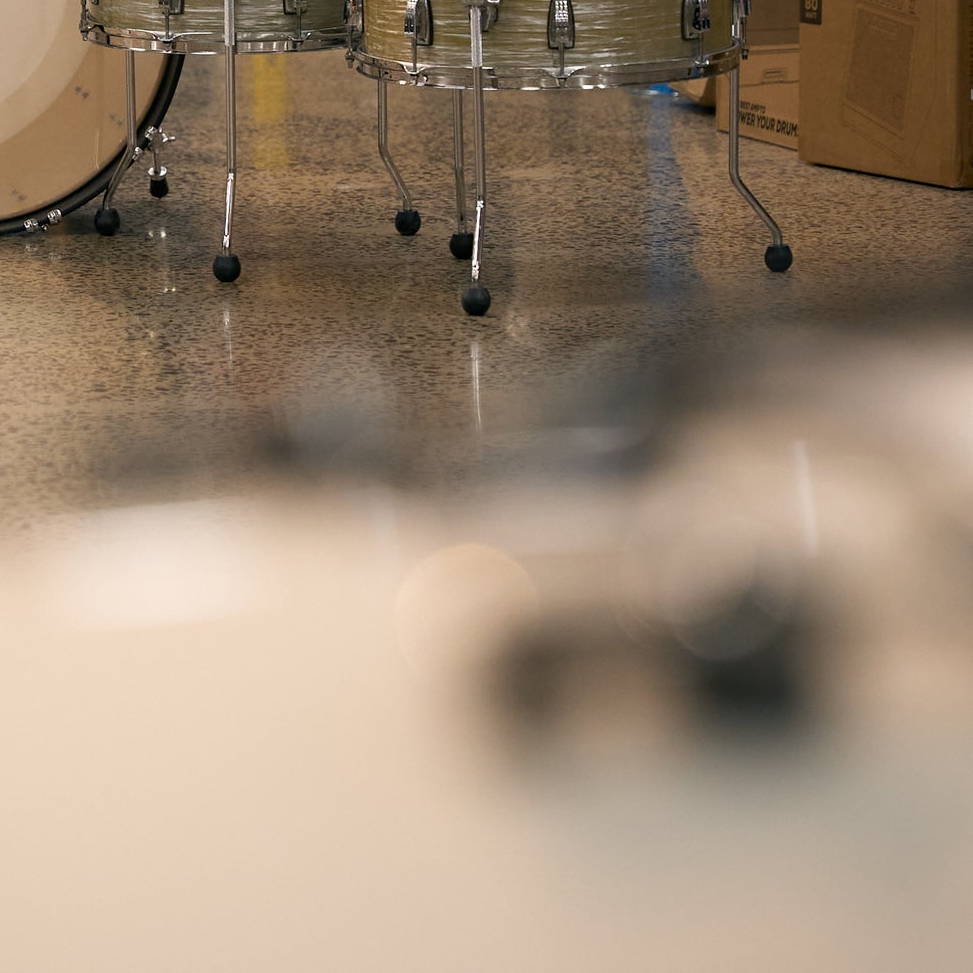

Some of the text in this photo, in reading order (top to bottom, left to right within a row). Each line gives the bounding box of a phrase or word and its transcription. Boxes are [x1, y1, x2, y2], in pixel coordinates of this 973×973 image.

[738, 112, 799, 137] WER YOUR DRUM
